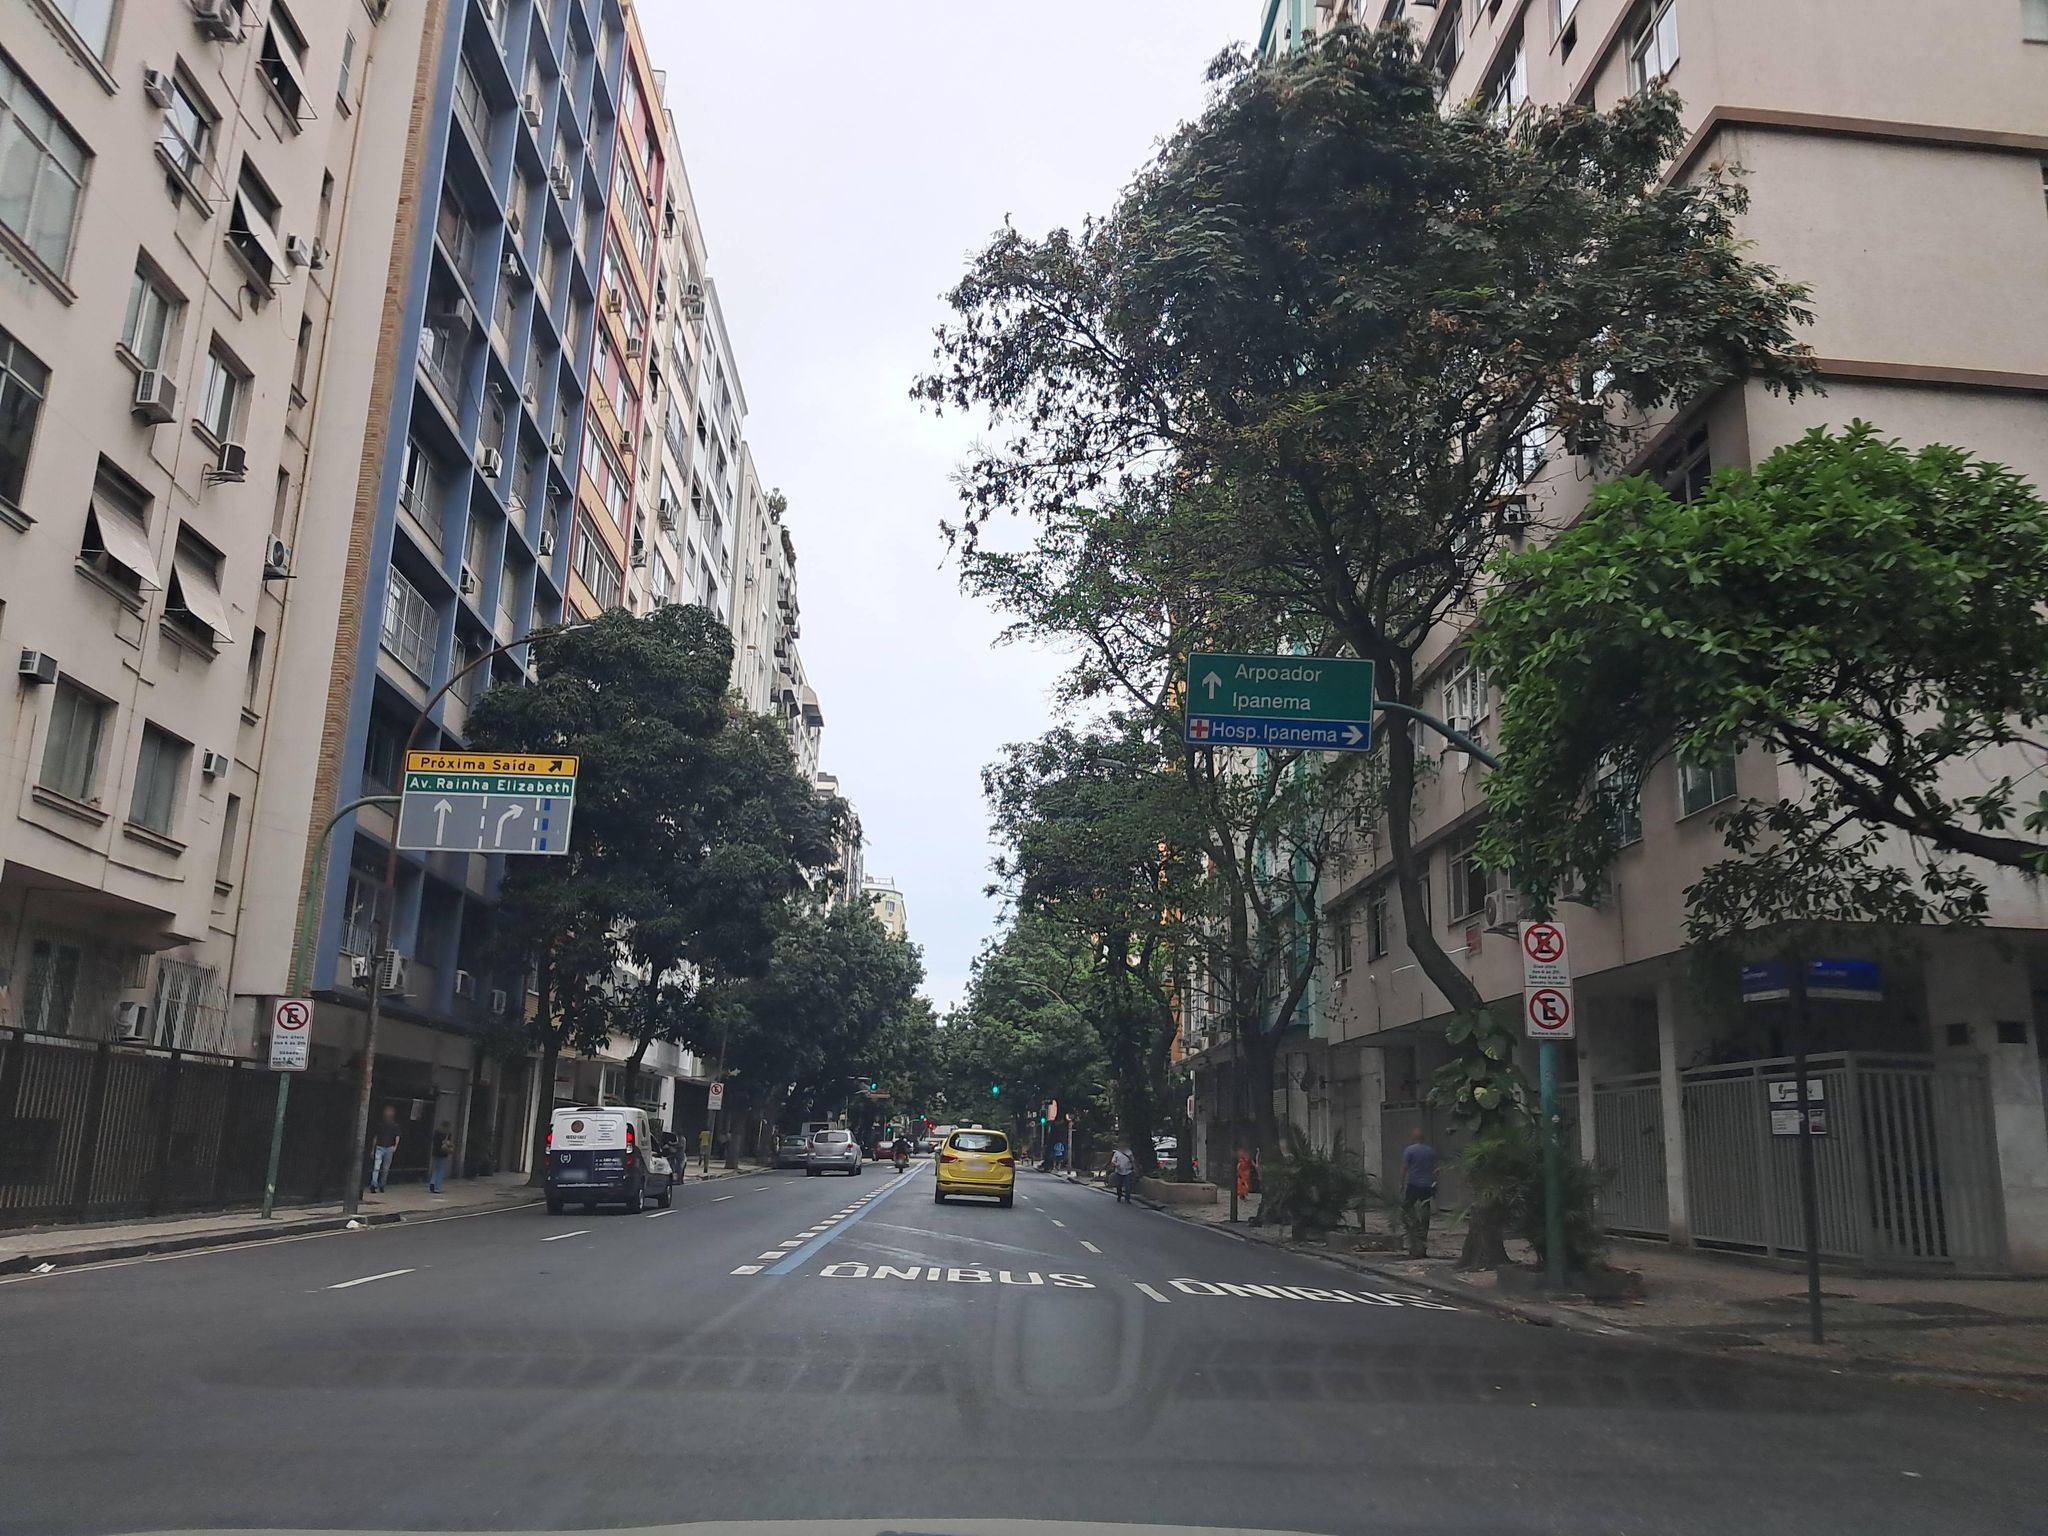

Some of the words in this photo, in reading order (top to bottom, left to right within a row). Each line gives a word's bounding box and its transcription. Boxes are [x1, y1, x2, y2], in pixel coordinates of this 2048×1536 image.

[1234, 663, 1323, 684] Arpoador
[1232, 691, 1312, 712] Ipanema
[1211, 721, 1261, 742] Hosp.
[1263, 723, 1338, 743] Ipanema
[420, 756, 486, 770] Próxima
[492, 759, 537, 772] Saída
[409, 776, 432, 789] Av.
[436, 777, 489, 791] Rainha
[496, 779, 570, 794] Elizabeth
[819, 1261, 1097, 1289] ÔNIBUS
[1167, 1278, 1461, 1312] ÔNIBUS
